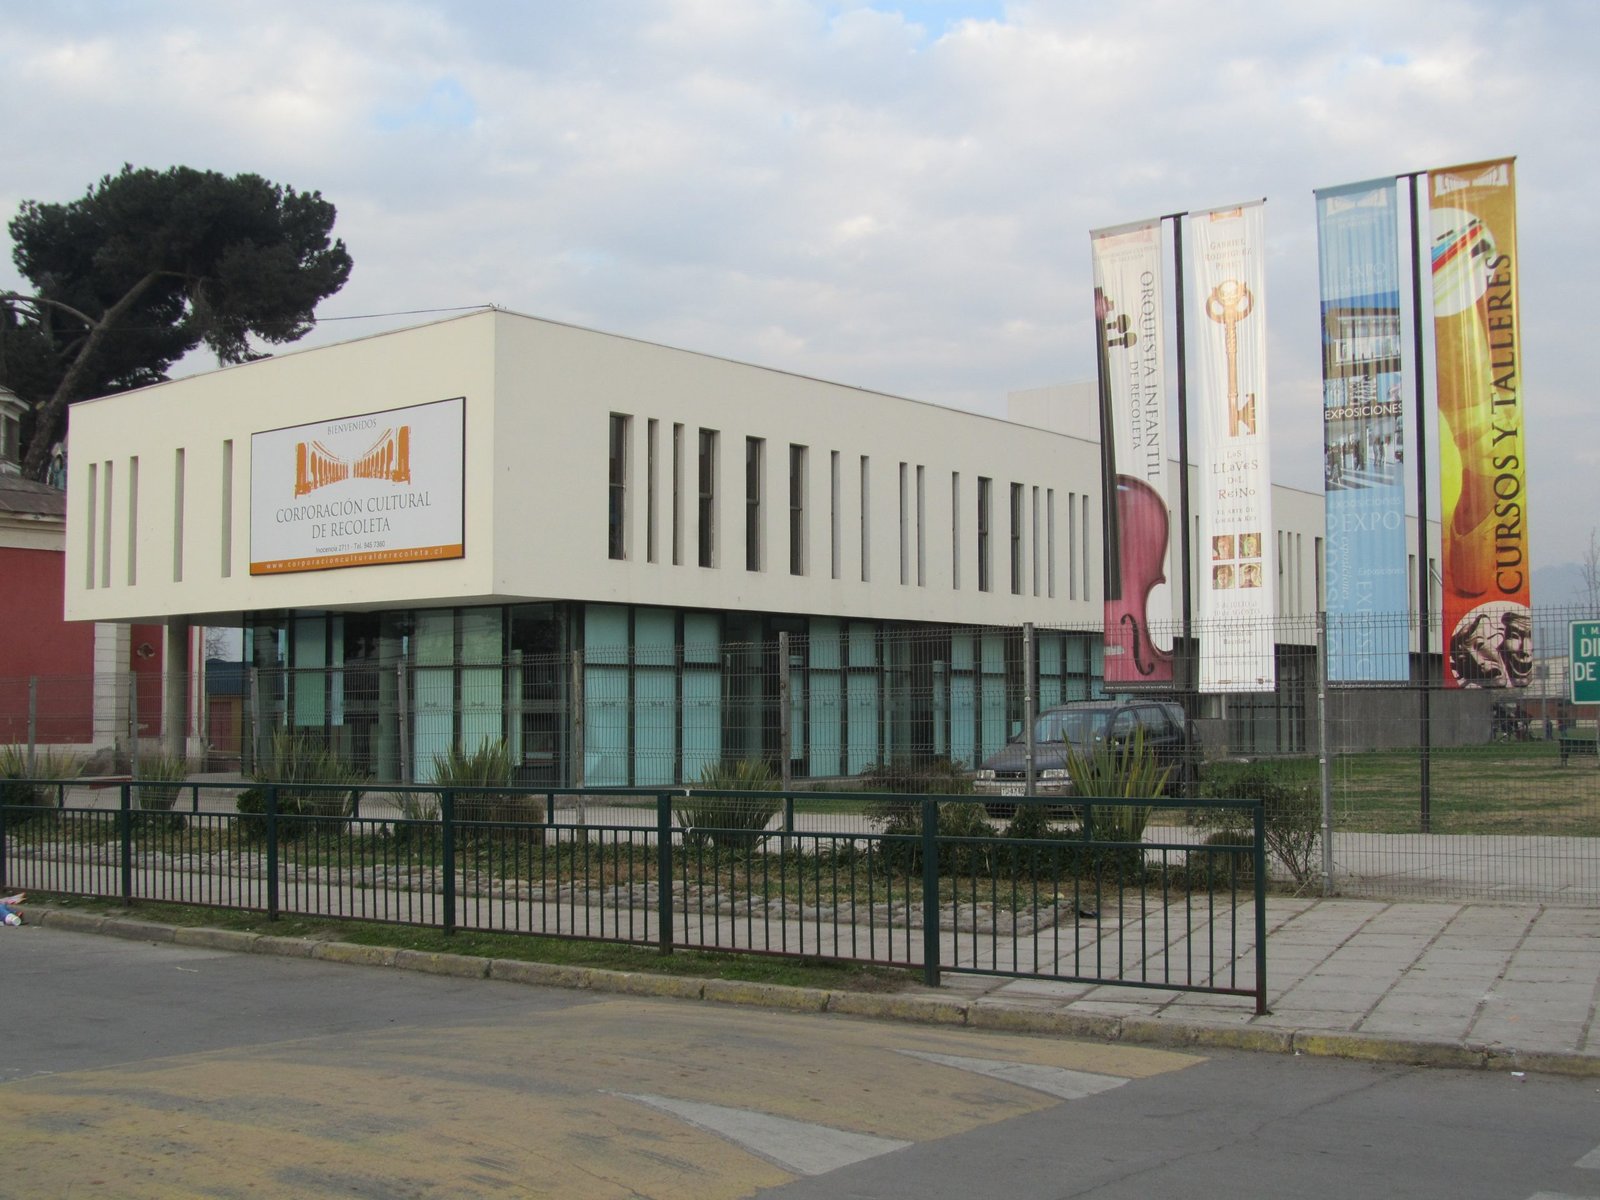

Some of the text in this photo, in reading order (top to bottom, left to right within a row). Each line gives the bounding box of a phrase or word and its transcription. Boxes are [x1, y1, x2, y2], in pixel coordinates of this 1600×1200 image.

[1139, 270, 1161, 481] ORQUESTA INFANTIL
[1130, 360, 1142, 450] DE RECOLETA
[1325, 402, 1402, 420] EXPOSICIONES
[327, 418, 377, 435] BIENVENIDOS
[1485, 254, 1523, 595] CURSOS Y TALLERES
[366, 491, 431, 512] CULTURAL
[312, 517, 391, 539] DE RECOLETA
[1343, 510, 1401, 532] EXPO
[1580, 637, 1600, 657] DI
[1574, 662, 1597, 681] DE
